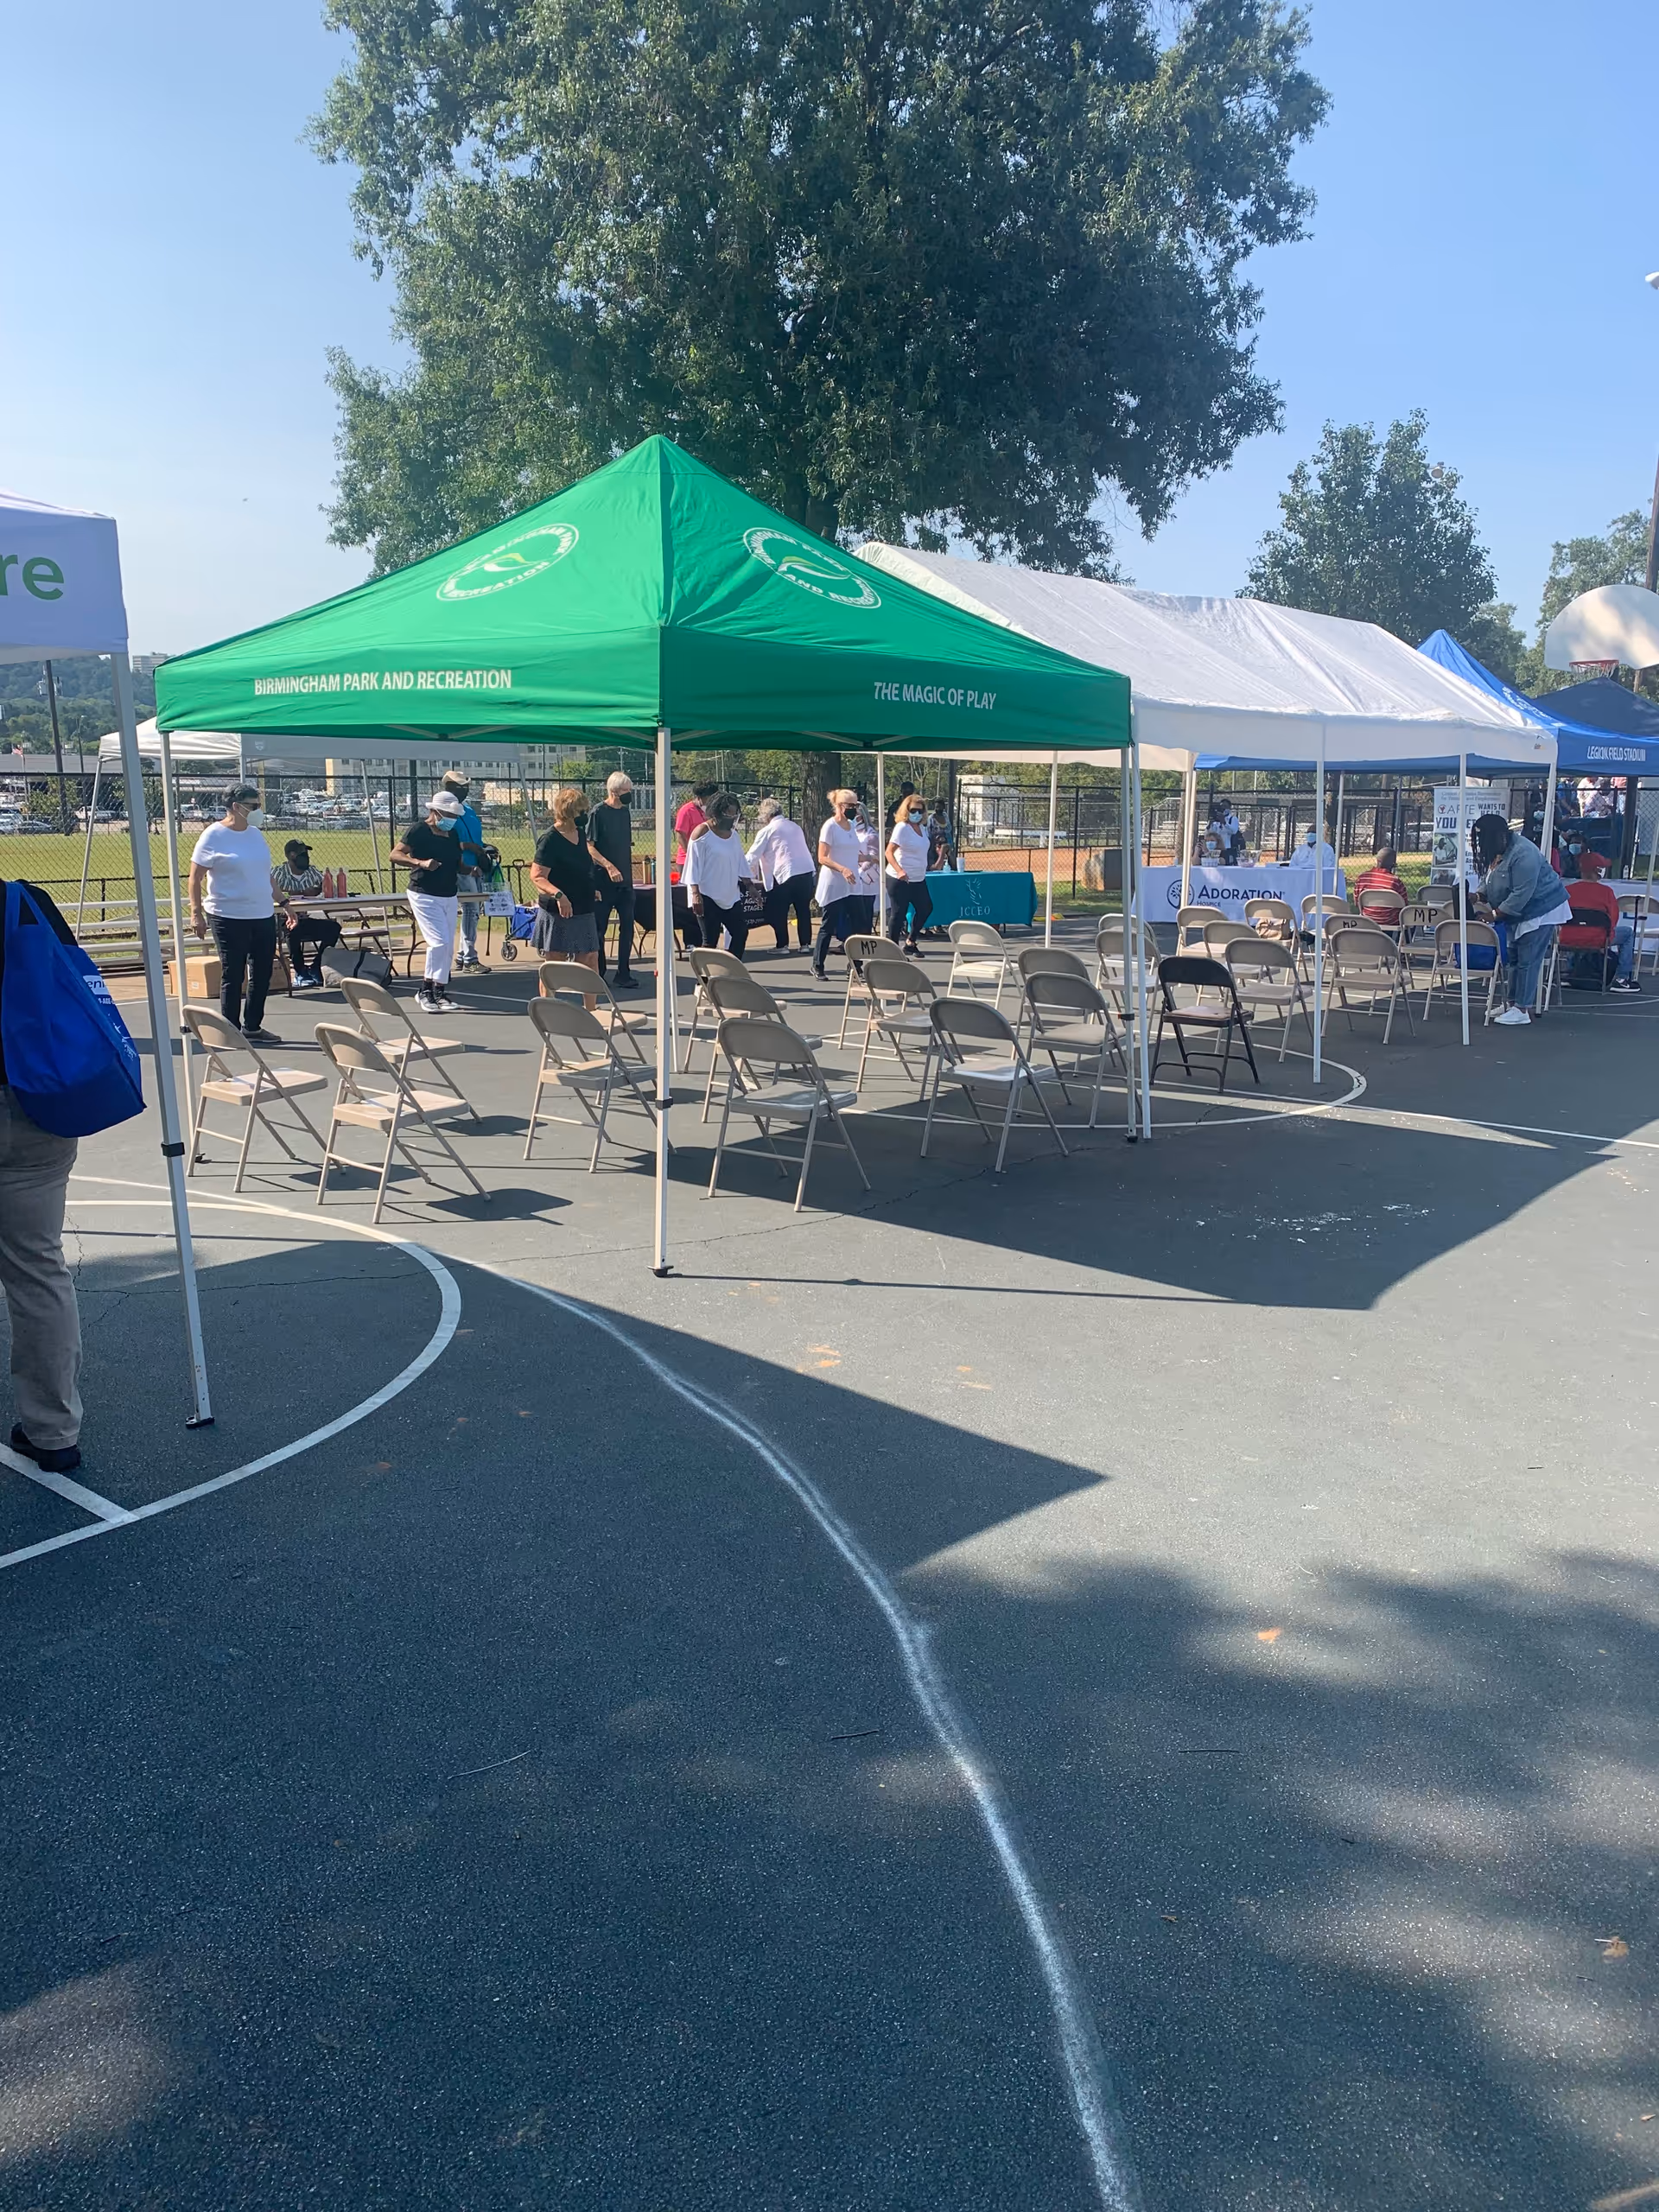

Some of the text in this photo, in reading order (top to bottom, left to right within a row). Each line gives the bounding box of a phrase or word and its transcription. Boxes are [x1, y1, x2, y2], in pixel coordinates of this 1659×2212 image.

[783, 574, 823, 594] AND
[254, 669, 512, 696] BIRMINGHAM PARK AND RECREATION
[874, 682, 997, 709] THE MAGIC OF PLAY
[1586, 745, 1646, 762] LEGION FIELD STADIUM
[1435, 817, 1457, 829] YOU
[1414, 908, 1438, 923] MP
[861, 940, 877, 955] MP
